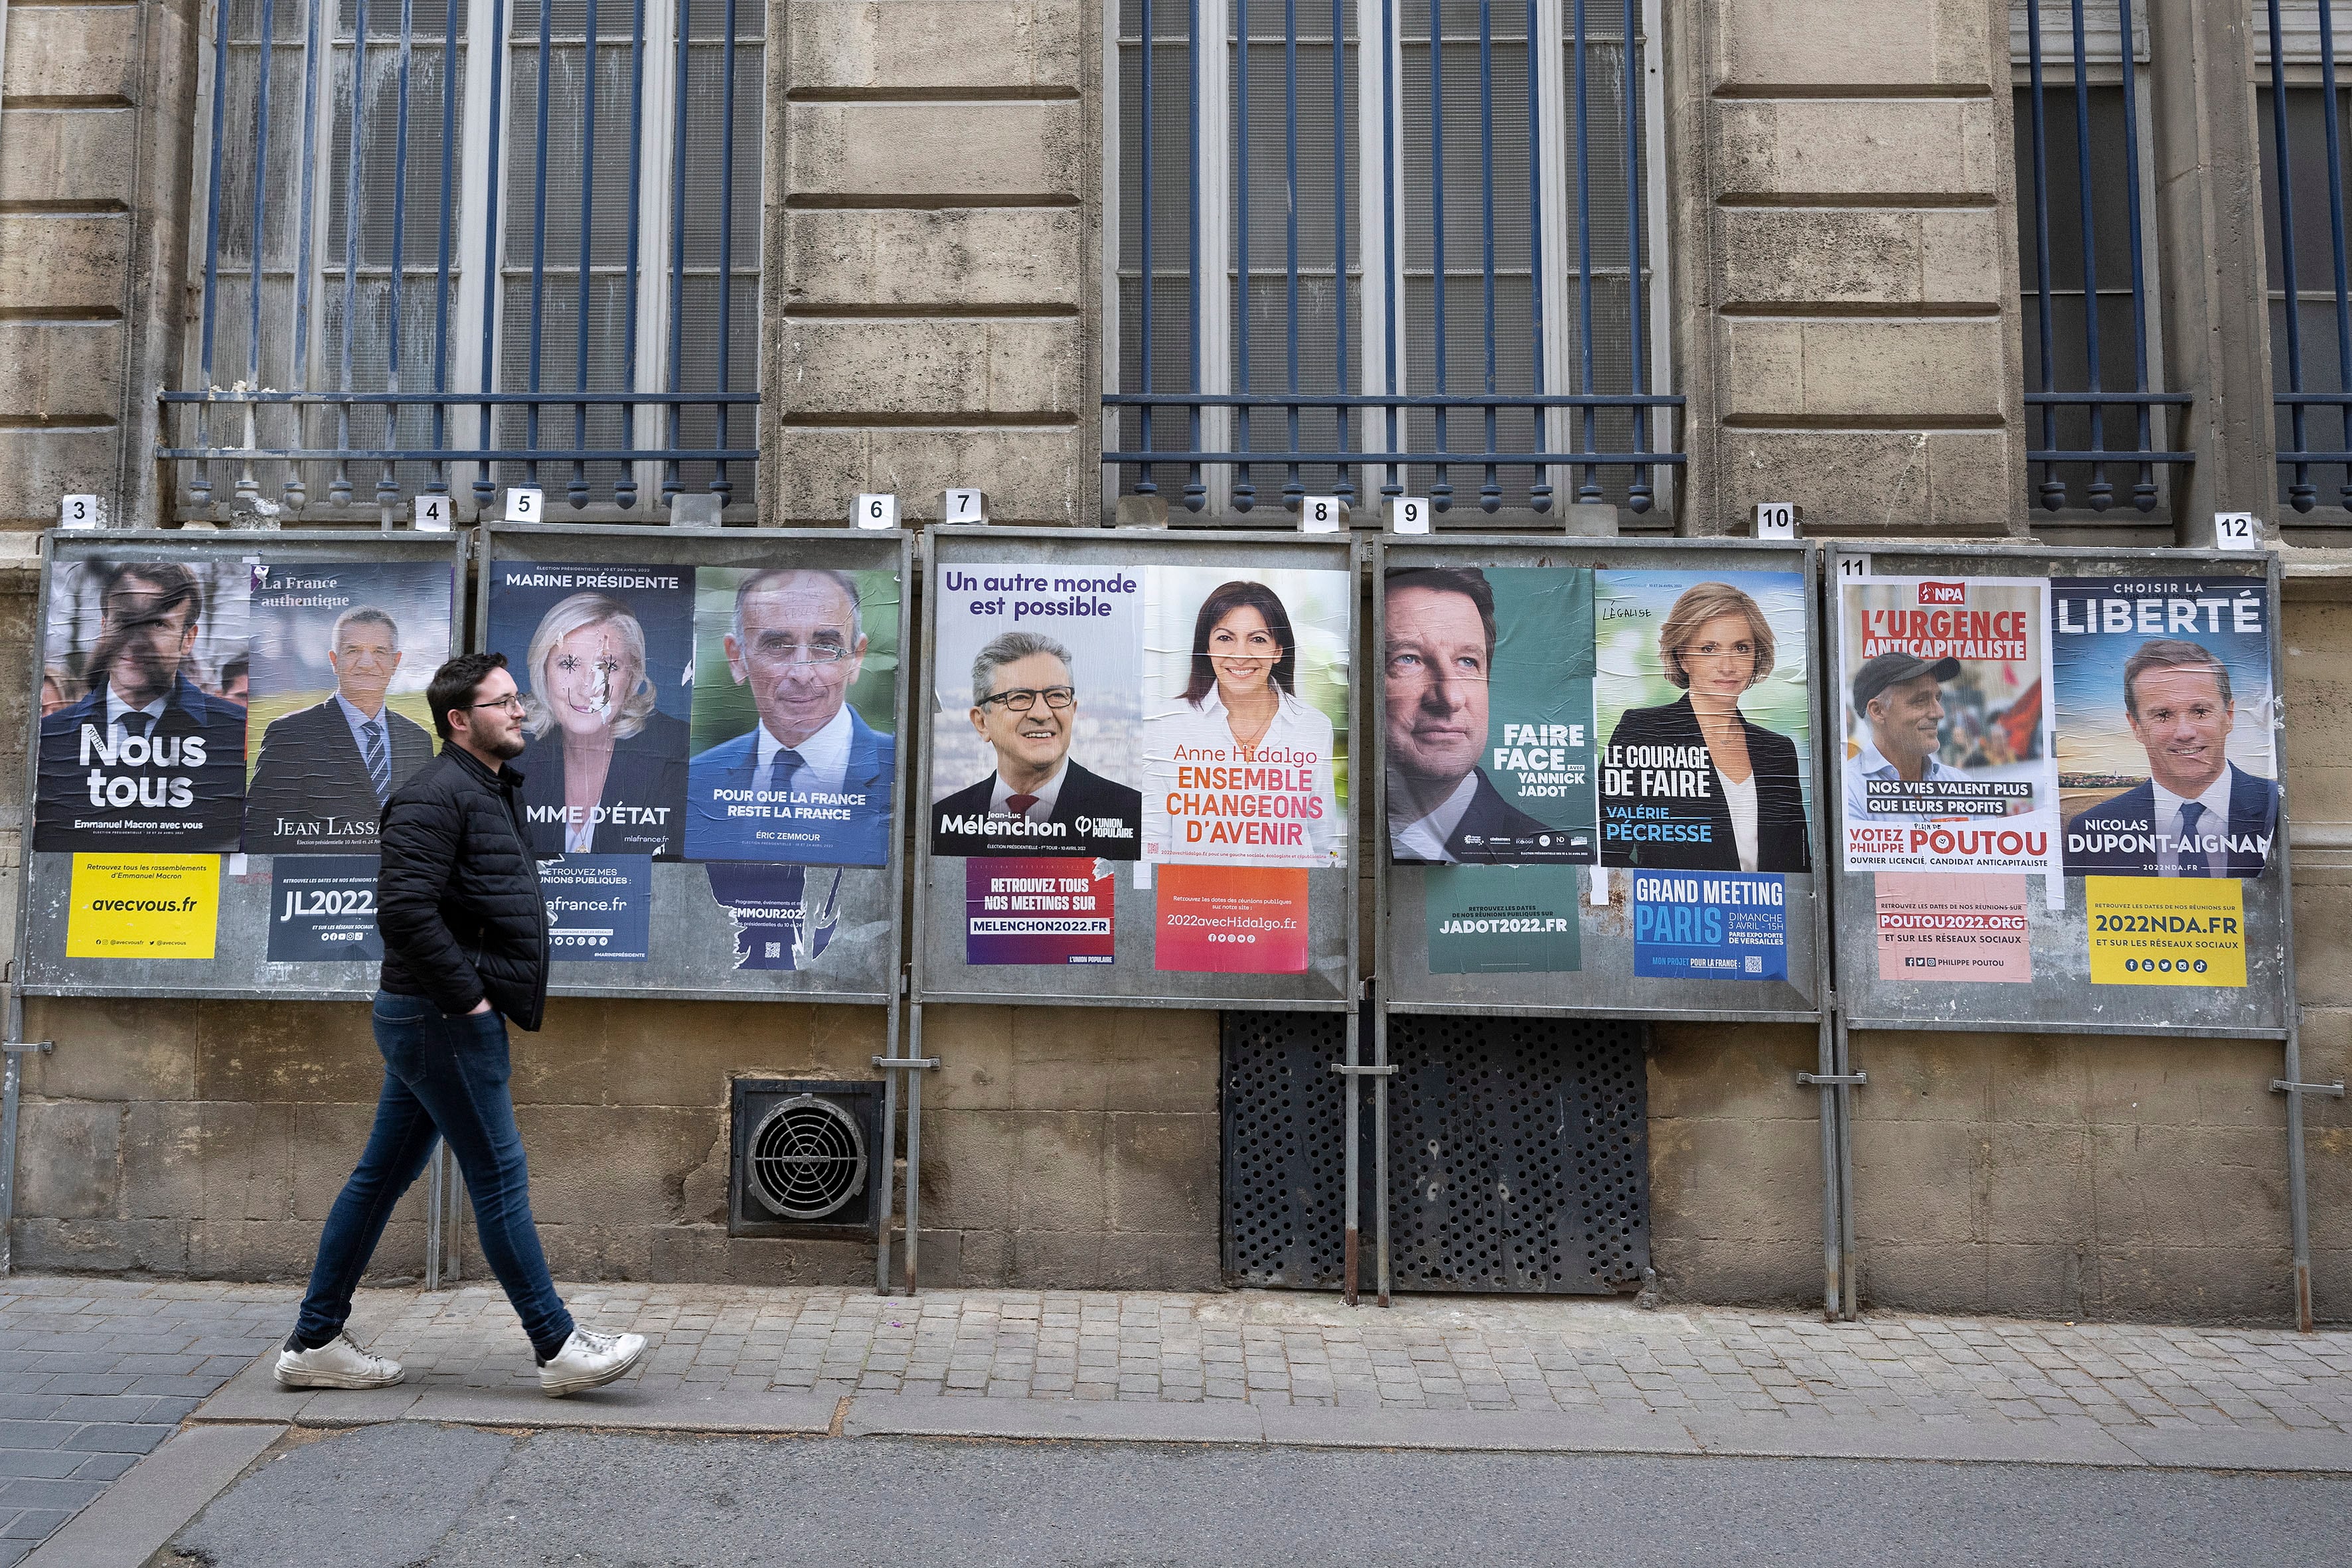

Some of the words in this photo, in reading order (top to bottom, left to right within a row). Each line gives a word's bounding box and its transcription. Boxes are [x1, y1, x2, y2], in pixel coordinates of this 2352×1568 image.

[74, 501, 85, 520] 3
[426, 502, 439, 520] 4
[518, 495, 530, 512] 5
[870, 501, 882, 518] 6
[957, 495, 970, 512] 7
[1315, 503, 1328, 521] 8
[1405, 503, 1417, 522] 9
[1763, 509, 1788, 528] 10
[2221, 518, 2248, 536] 12
[1842, 559, 1863, 576] 11
[262, 578, 281, 589] La
[286, 578, 337, 589] France
[507, 574, 572, 587] MARINE
[576, 572, 678, 589] PRÉSIDENTE
[947, 572, 977, 591] Un
[984, 574, 1048, 591] autre
[1054, 573, 1137, 593] monde
[2114, 584, 2178, 593] CHOISIR
[2186, 583, 2204, 593] LA
[262, 594, 349, 609] authentique
[1935, 588, 1963, 601] NPA
[970, 597, 1005, 615] est
[1014, 596, 1111, 621] possible
[1603, 600, 1652, 620] LÉGALISE
[2059, 589, 2262, 633] LIBERTÉ
[1861, 610, 2026, 638] L'URGENCE
[1864, 639, 2025, 659] ANTICAPITALISTE
[1504, 724, 1585, 746] FAIRE
[80, 724, 206, 767] Nous
[1174, 744, 1225, 761] Anne
[1233, 745, 1317, 767] Hidalgo
[1494, 748, 1565, 771] FACE
[1605, 745, 1622, 767] LE
[1626, 745, 1709, 769] COURAGE
[1179, 766, 1312, 791] ENSEMBLE
[1518, 772, 1585, 784] YANNICK
[1605, 769, 1634, 796] DE
[1641, 769, 1710, 797] FAIRE
[87, 769, 194, 808] tous
[714, 789, 754, 802] POUR
[756, 791, 787, 803] QUE
[790, 792, 807, 803] LA
[811, 793, 866, 805] FRANCE
[1518, 786, 1567, 797] JADOT
[1869, 782, 1900, 793] NOS
[1904, 783, 1934, 794] VIES
[1938, 783, 1991, 795] VALENT
[1994, 784, 2028, 796] PLUS
[526, 806, 583, 823] MME
[589, 801, 670, 824] D'ÉTAT
[728, 806, 771, 817] RESTE
[774, 807, 792, 818] LA
[795, 808, 850, 820] FRANCE
[1166, 793, 1322, 819] CHANGEONS
[1606, 804, 1669, 819] VALÉRIE
[1869, 800, 1898, 812] QUE
[1903, 801, 1944, 813] LEURS
[1948, 801, 2003, 813] PROFITS
[987, 811, 1021, 820] Jean-Luc
[1093, 817, 1123, 828] L'UNION
[74, 820, 122, 828] Emmanuel
[125, 821, 157, 829] Macron
[274, 818, 321, 836] JEAN
[941, 815, 1066, 837] Mélenchon
[1093, 827, 1133, 838] POPULAIRE
[1187, 821, 1302, 845] D'AVENIR
[1607, 820, 1712, 842] PÉCRESSE
[2085, 819, 2148, 830] NICOLAS
[756, 830, 775, 839] ÉRIC
[777, 832, 820, 841] ZEMMOUR
[1850, 828, 1904, 841] VOTEZ
[1911, 829, 2047, 856] POUTOU
[1850, 843, 1904, 853] PHILIPPE
[1889, 856, 1927, 865] LICENCIÉ,
[991, 878, 1056, 893] RETROUVEZ
[1059, 878, 1089, 892] TOUS
[1636, 878, 1698, 903] GRAND
[1703, 880, 1782, 906] MEETING
[92, 897, 197, 911] avecvous.fr
[984, 896, 1008, 910] NOS
[1012, 896, 1069, 910] MEETINGS
[1073, 896, 1095, 910] SUR
[974, 921, 1107, 931] MELENCHON2022.FR
[1167, 915, 1296, 931] 2022avecHidalgo.fr
[1439, 919, 1567, 933] JADOT2022.FR
[1636, 905, 1721, 943] PARIS
[1729, 913, 1782, 923] DIMANCHE
[1881, 915, 2023, 929] POUTOU2022.ORG
[2096, 915, 2237, 934] 2022NDA.FR
[1936, 933, 1976, 943] RÉSEAUX
[2150, 939, 2192, 948] RÉSEAUX
[1715, 959, 1737, 968] FRANCE
